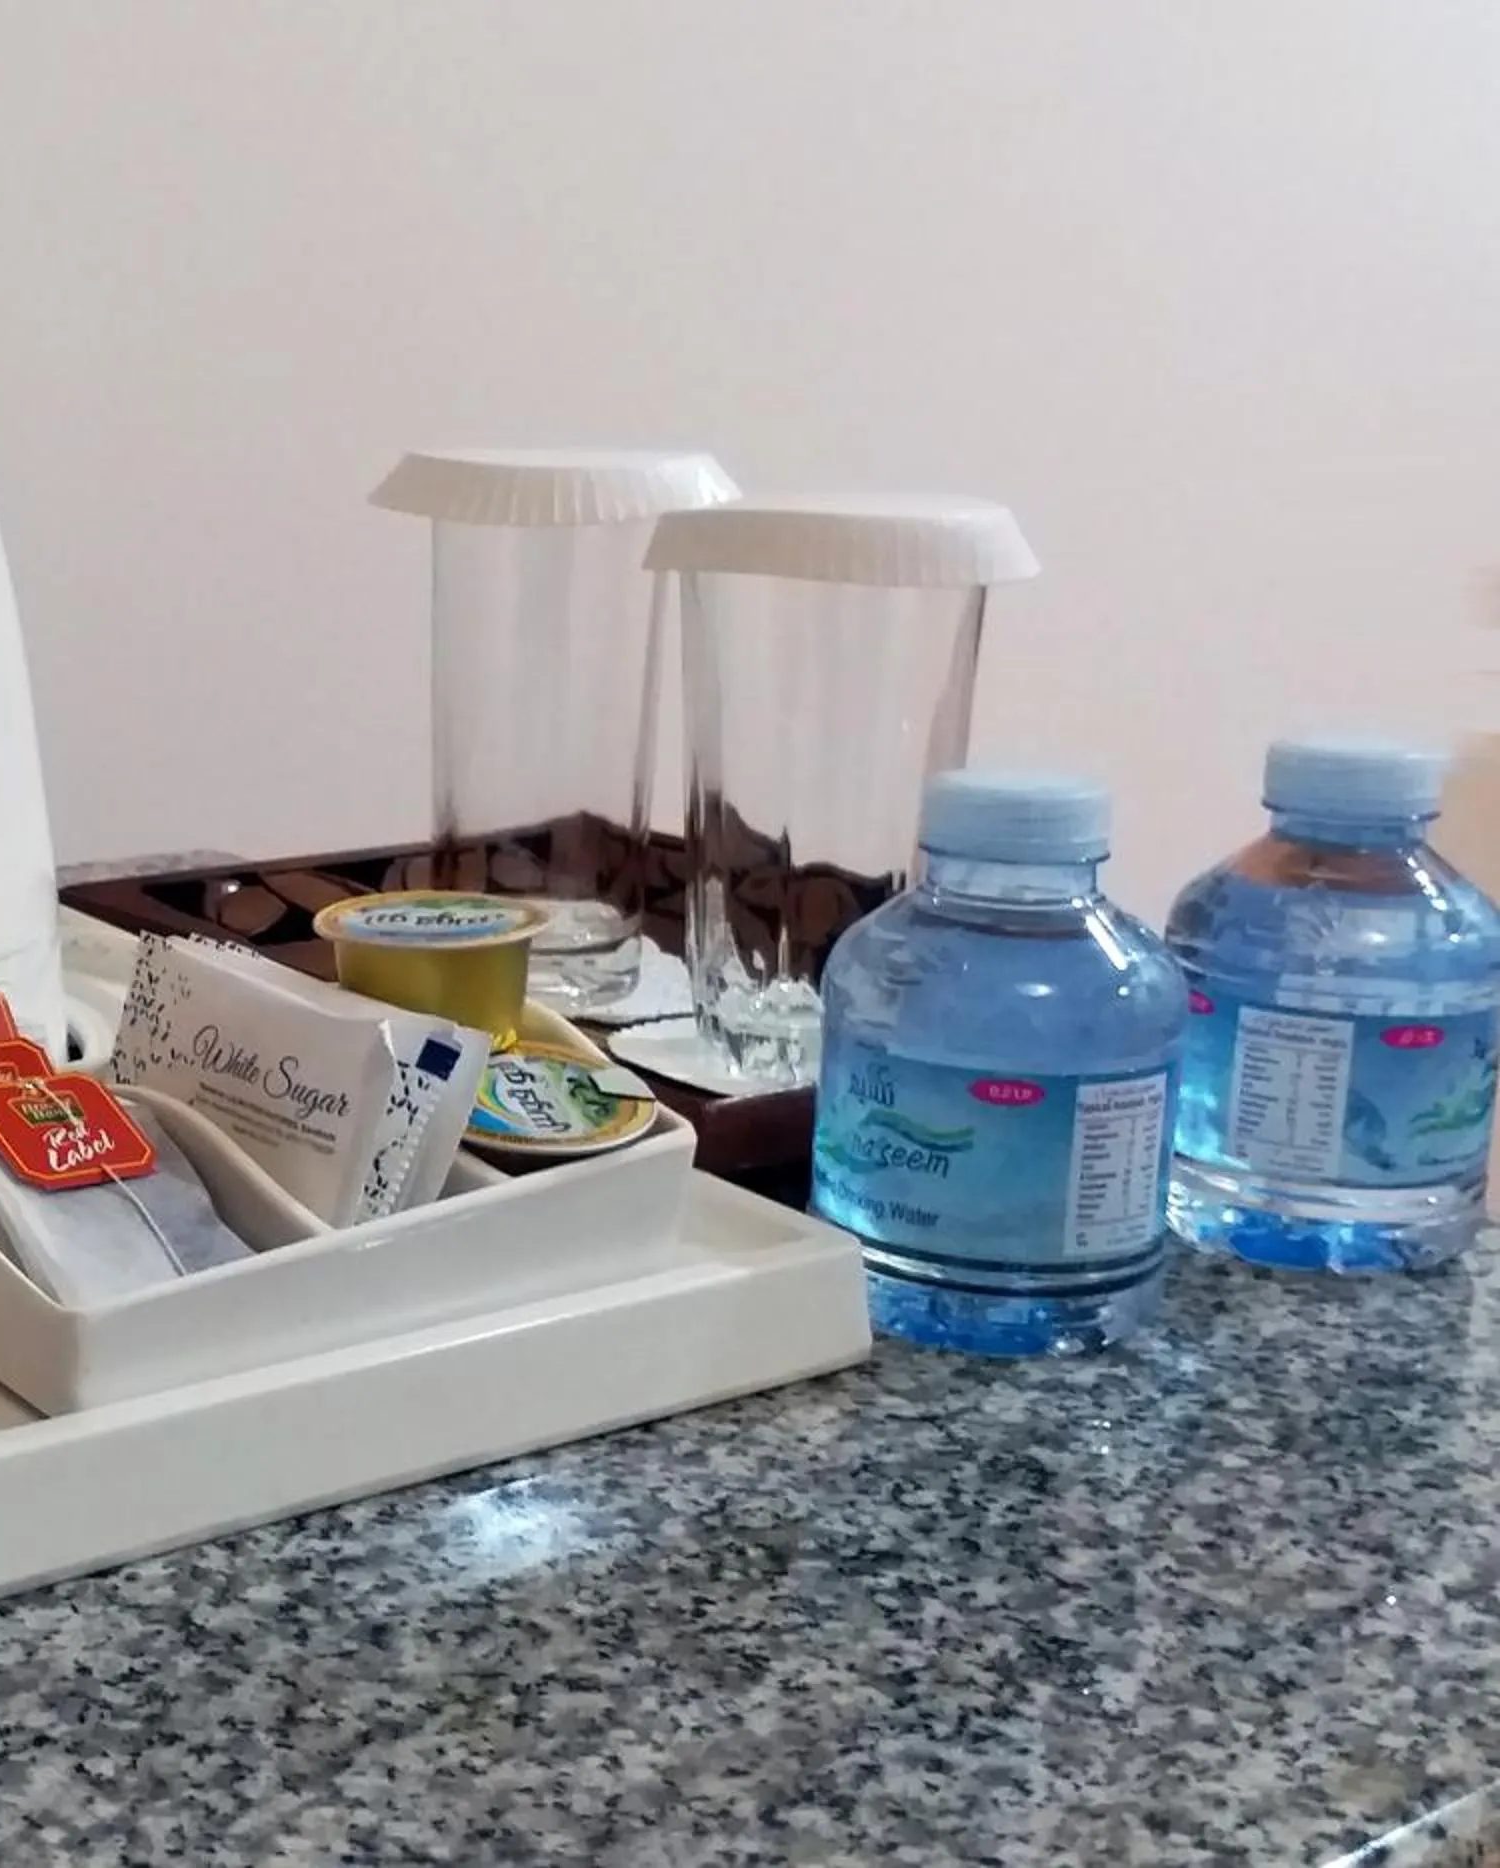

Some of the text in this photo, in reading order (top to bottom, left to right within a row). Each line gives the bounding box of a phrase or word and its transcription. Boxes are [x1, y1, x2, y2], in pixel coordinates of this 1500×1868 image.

[193, 1023, 261, 1085] White
[263, 1055, 350, 1121] Sugar
[41, 1120, 91, 1149] Red
[47, 1129, 115, 1172] Label
[889, 1200, 941, 1227] Water
